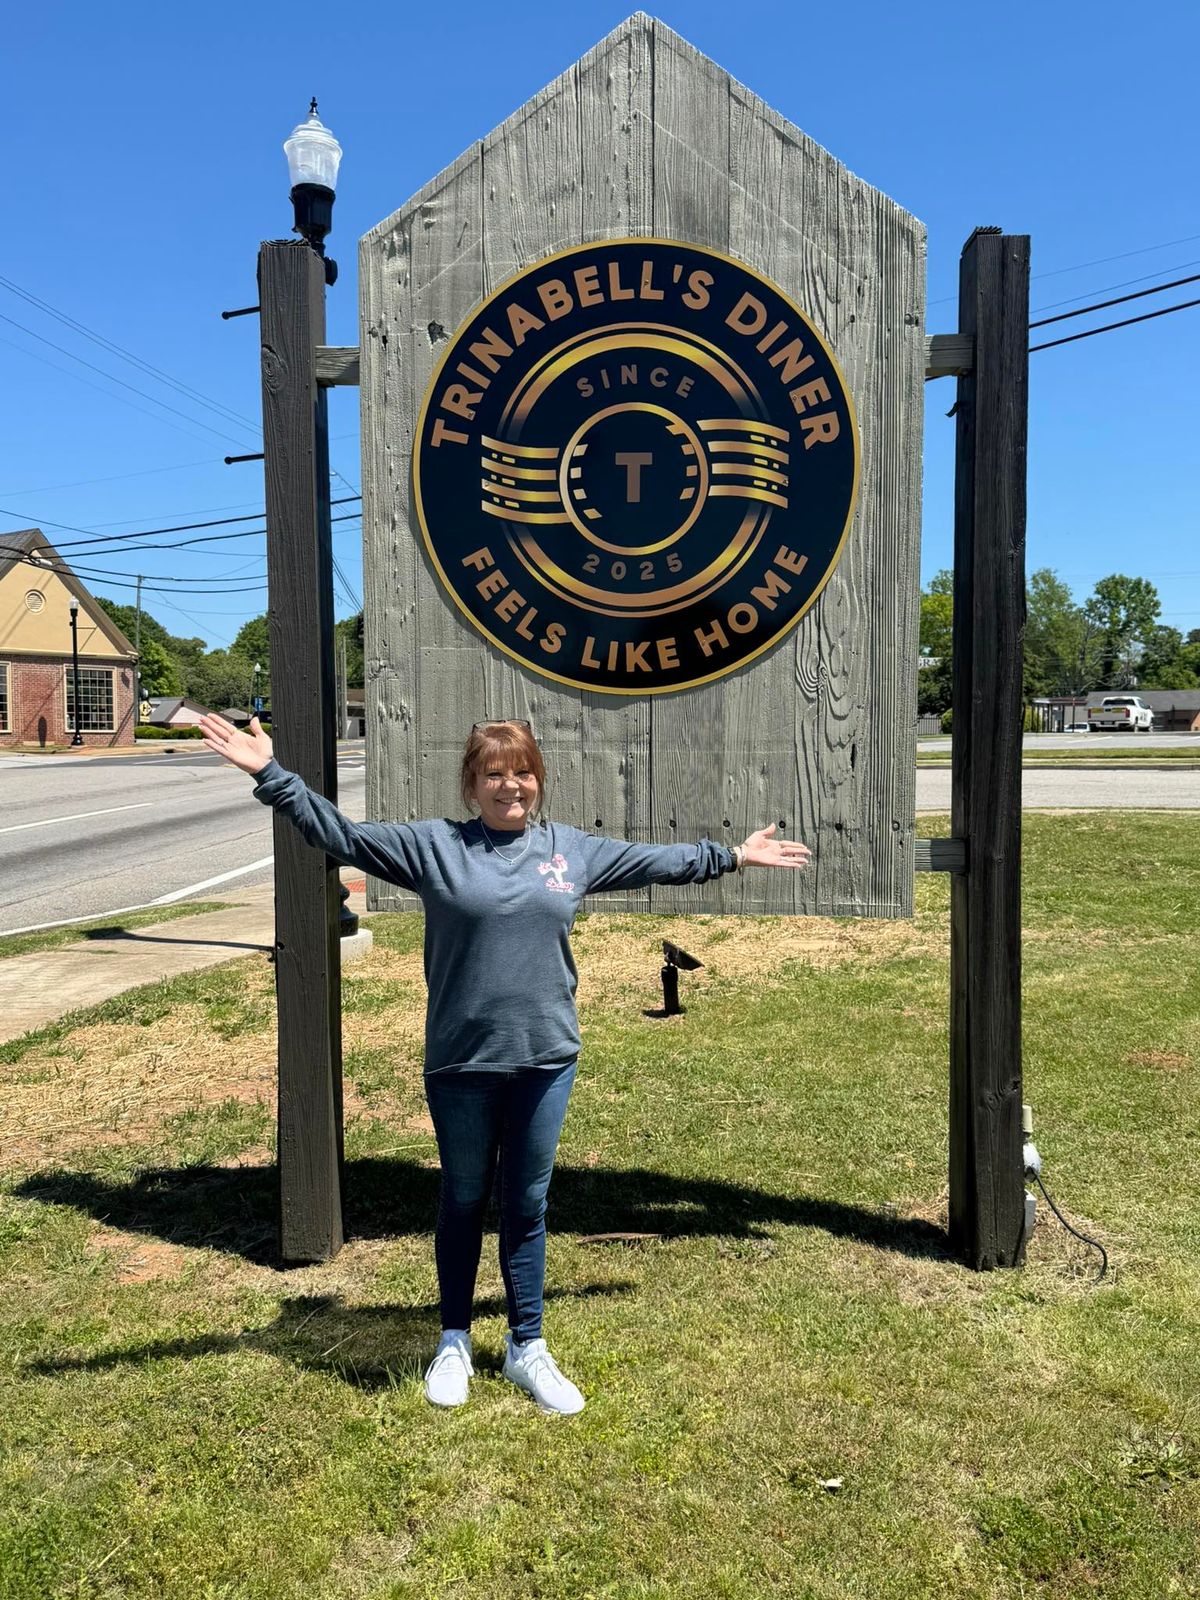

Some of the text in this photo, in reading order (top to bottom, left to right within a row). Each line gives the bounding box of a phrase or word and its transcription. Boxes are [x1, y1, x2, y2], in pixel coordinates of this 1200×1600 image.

[431, 261, 839, 449] TRINABELL'S DINER
[577, 365, 694, 398] SINCE
[616, 453, 652, 502] T
[583, 553, 682, 579] 2025
[462, 545, 808, 673] FEELS LIKE HOME
